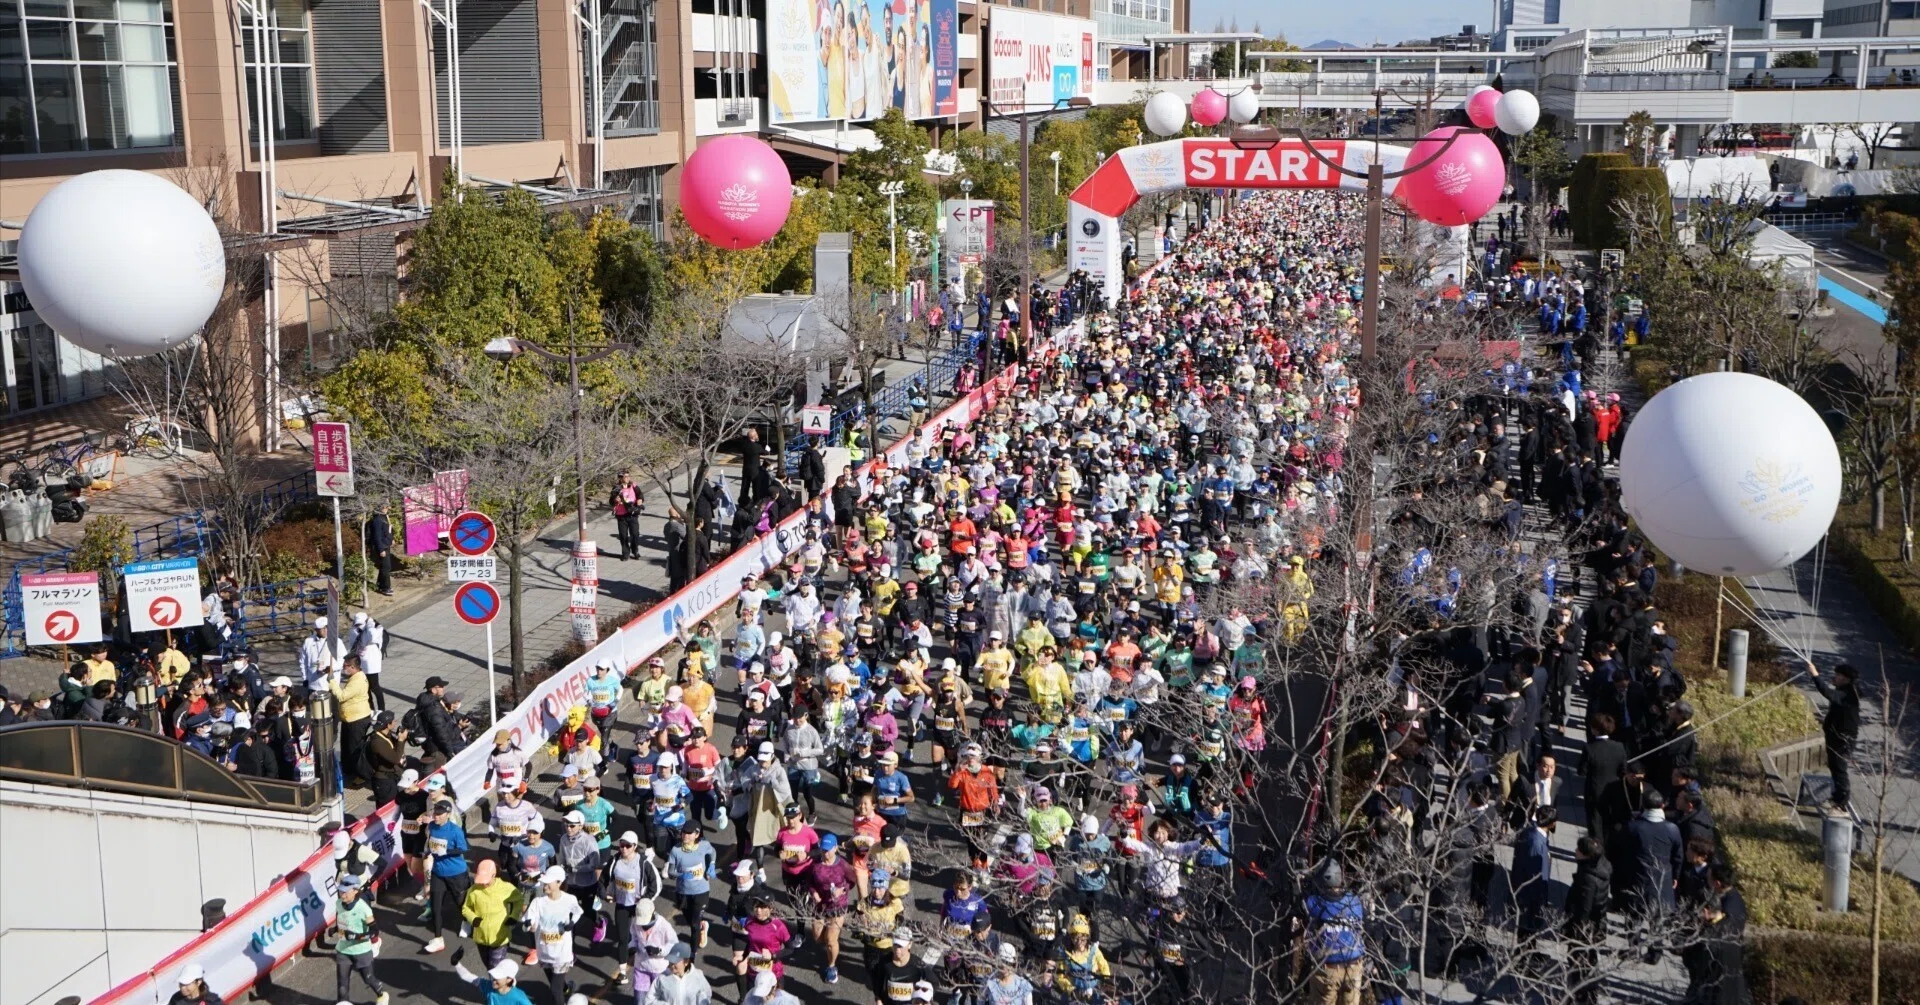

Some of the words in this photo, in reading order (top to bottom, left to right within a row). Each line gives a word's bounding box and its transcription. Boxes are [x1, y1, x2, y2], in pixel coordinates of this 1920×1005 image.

[994, 38, 1022, 57] docomo
[1189, 149, 1339, 182] START
[970, 207, 982, 222] P
[811, 416, 822, 428] A
[317, 430, 330, 466] 自転車
[331, 430, 345, 467] 歩行者
[450, 559, 493, 568] 野球開催日
[31, 588, 92, 600] フルマラソン
[687, 575, 721, 617] KOSÉ
[251, 891, 322, 954] Niterra
